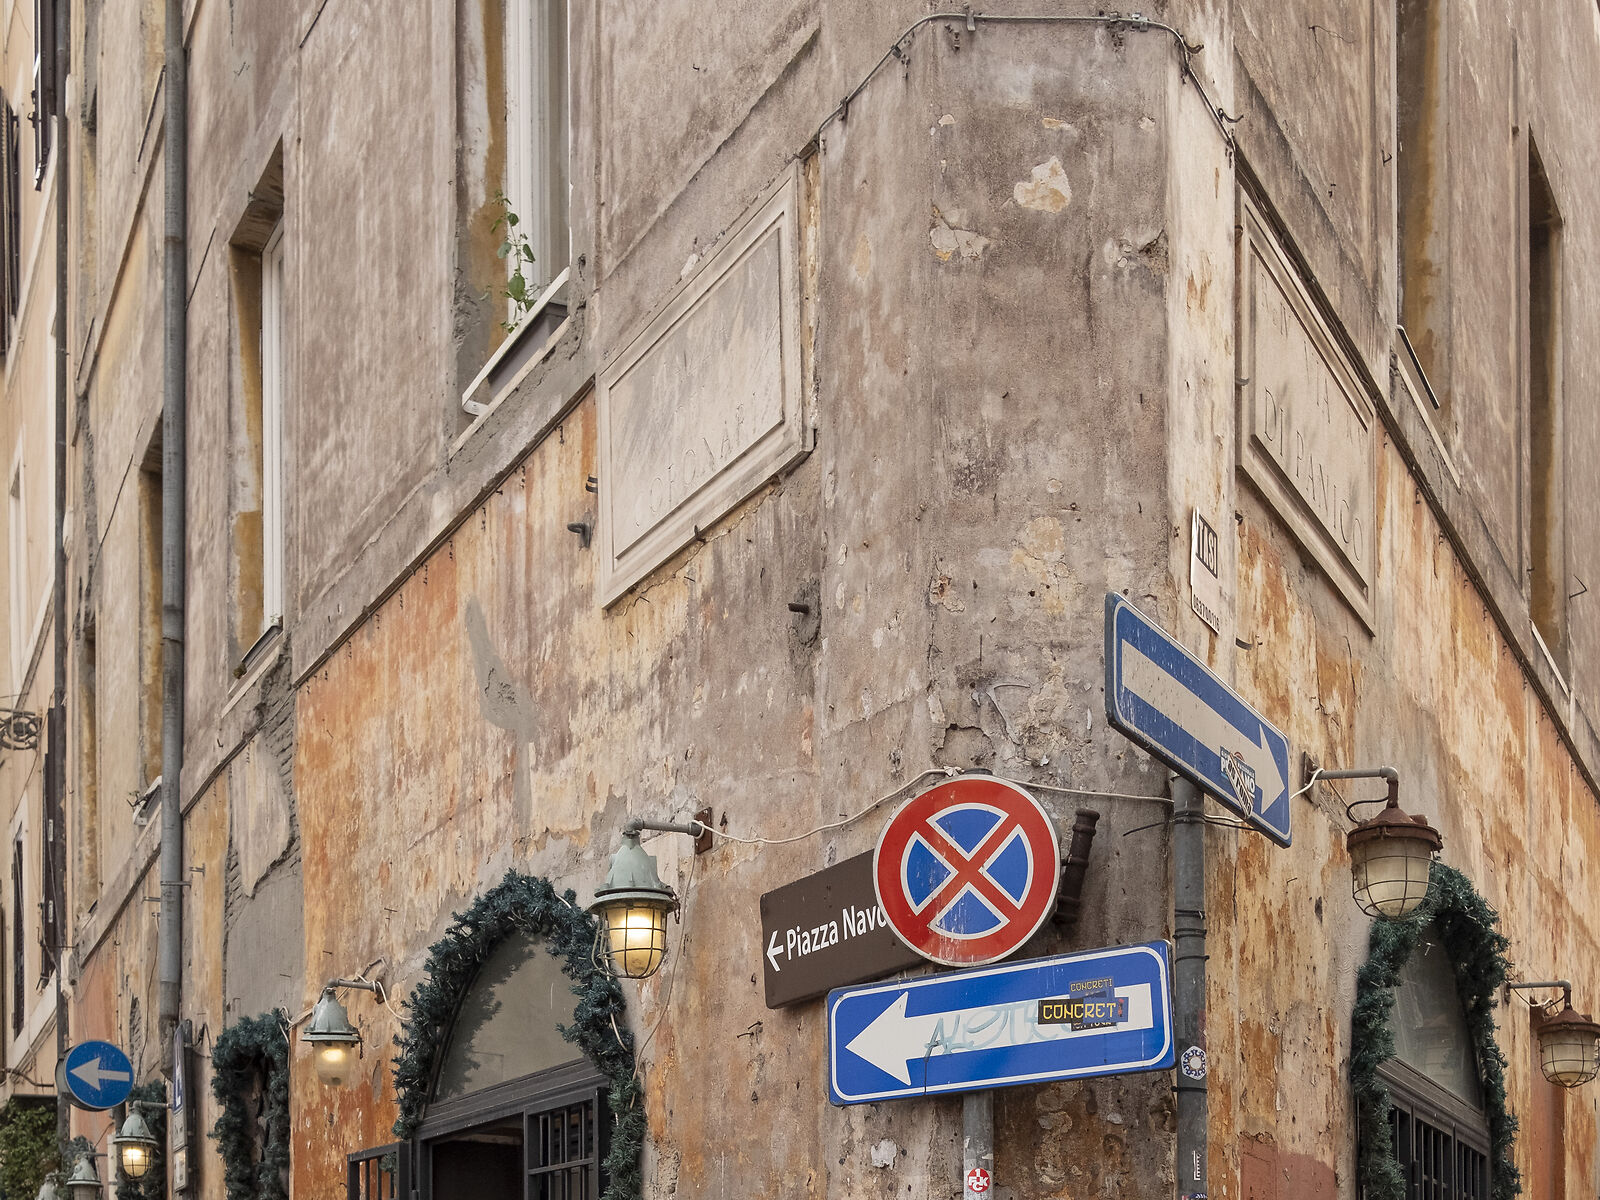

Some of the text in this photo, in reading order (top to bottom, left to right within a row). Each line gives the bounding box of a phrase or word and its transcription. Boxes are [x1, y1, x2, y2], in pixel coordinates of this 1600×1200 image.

[1264, 385, 1364, 563] DI PANICO
[786, 920, 839, 961] Piazza
